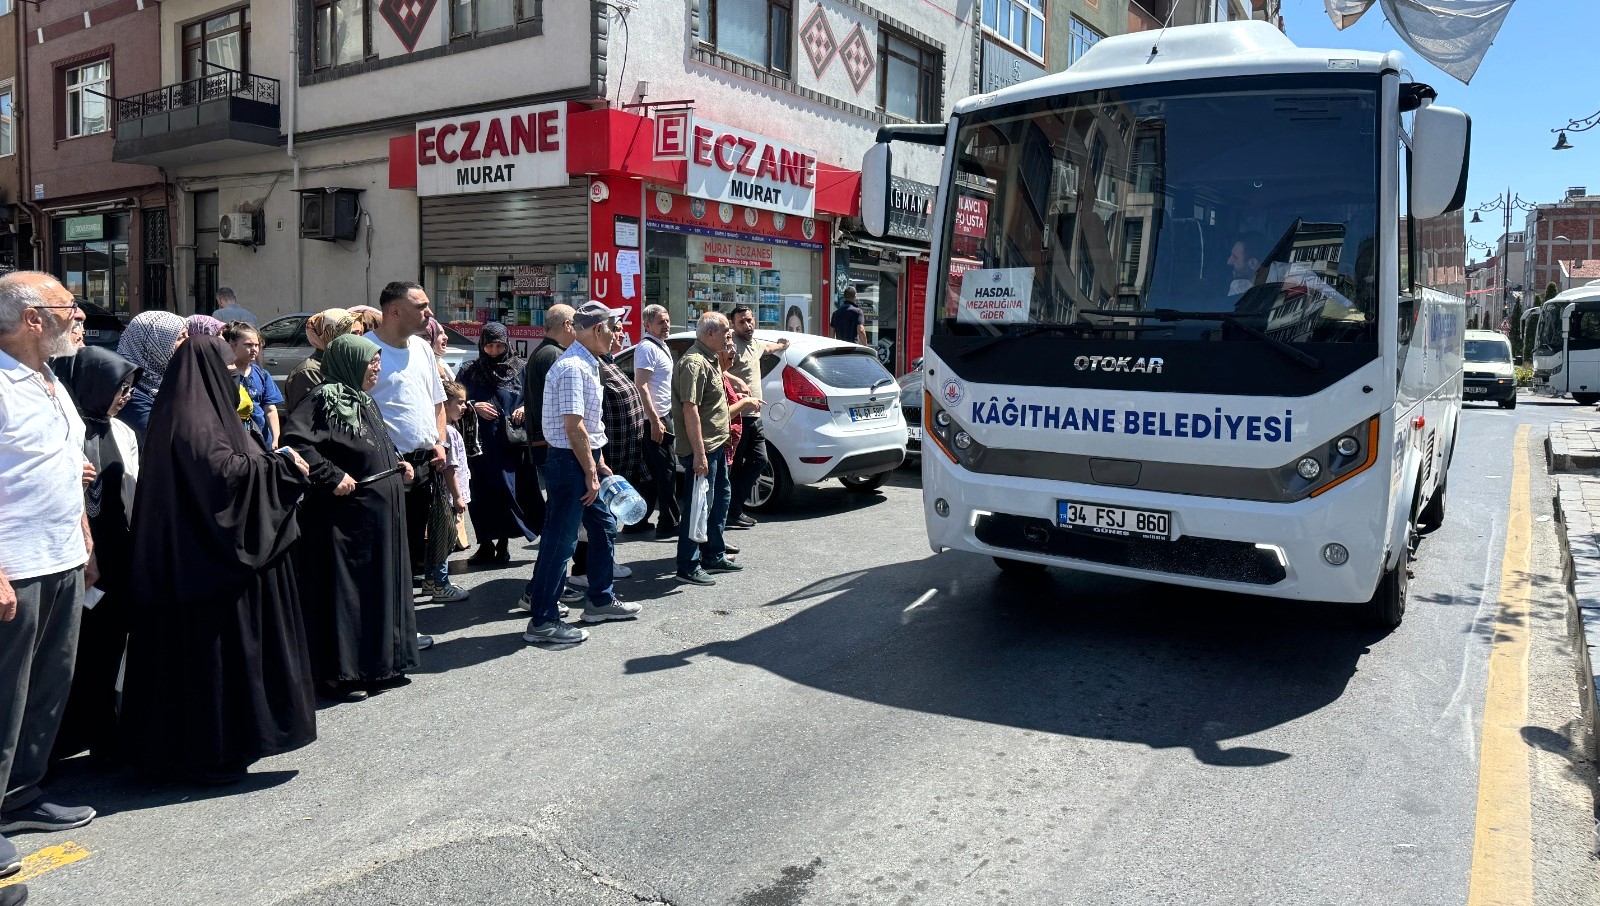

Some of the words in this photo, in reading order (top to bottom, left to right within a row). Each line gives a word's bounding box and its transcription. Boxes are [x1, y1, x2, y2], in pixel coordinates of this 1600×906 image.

[418, 110, 559, 166] ECZANE
[663, 118, 681, 151] E
[694, 125, 816, 189] ECZANE
[457, 164, 515, 186] MURAT
[731, 179, 782, 205] MURAT
[704, 241, 732, 255] MURAT
[735, 245, 773, 260] ECZANESİ
[966, 298, 1022, 310] MEZARLIĞINA
[975, 287, 1016, 298] HASDAL
[980, 310, 1005, 320] GİDER
[1073, 355, 1164, 374] OTOKAR
[972, 396, 1116, 433] KÂĞITHANE
[1124, 407, 1292, 443] BELEDİYESİ
[1068, 505, 1087, 524] 34
[1096, 508, 1126, 528] FSJ
[1136, 513, 1167, 533] 860
